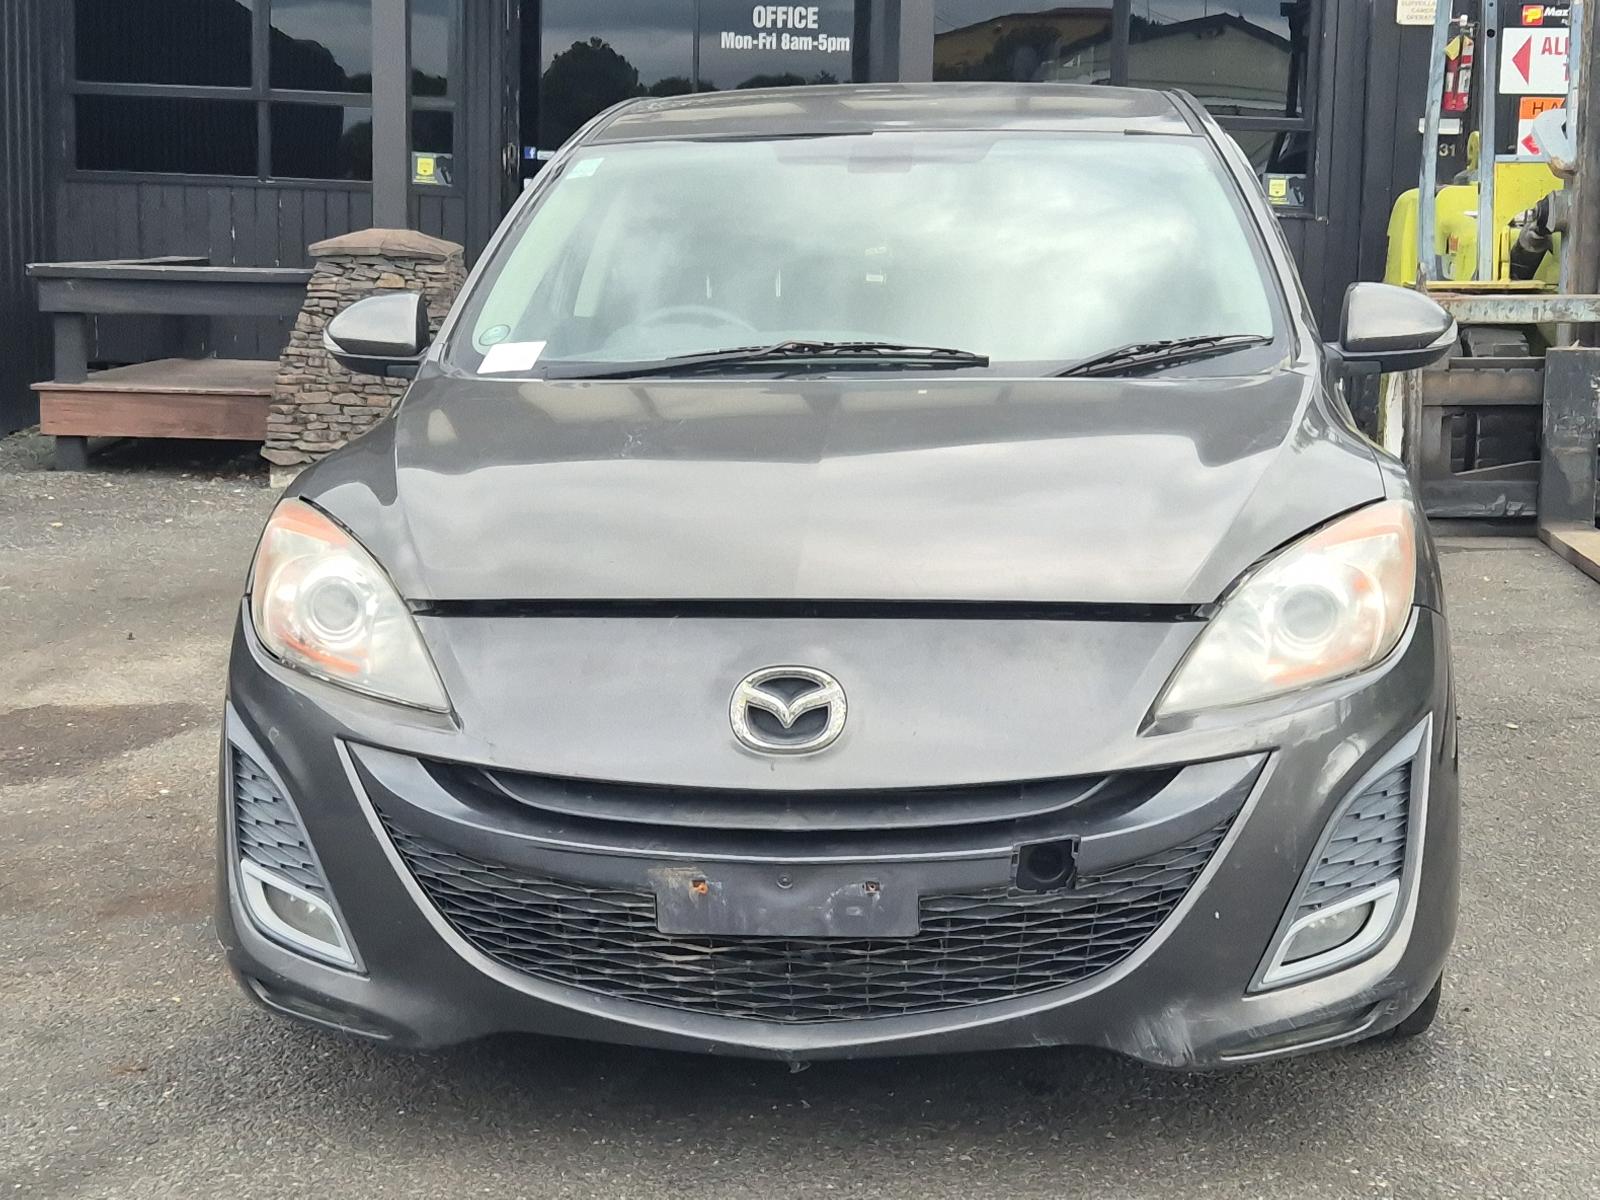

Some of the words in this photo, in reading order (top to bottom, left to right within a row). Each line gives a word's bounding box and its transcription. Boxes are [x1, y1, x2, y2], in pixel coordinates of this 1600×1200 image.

[752, 5, 819, 29] OFFICE
[1543, 6, 1571, 17] Max
[720, 31, 777, 50] Mon-Fri
[781, 33, 850, 53] 8am-5pm
[1439, 143, 1456, 157] 31
